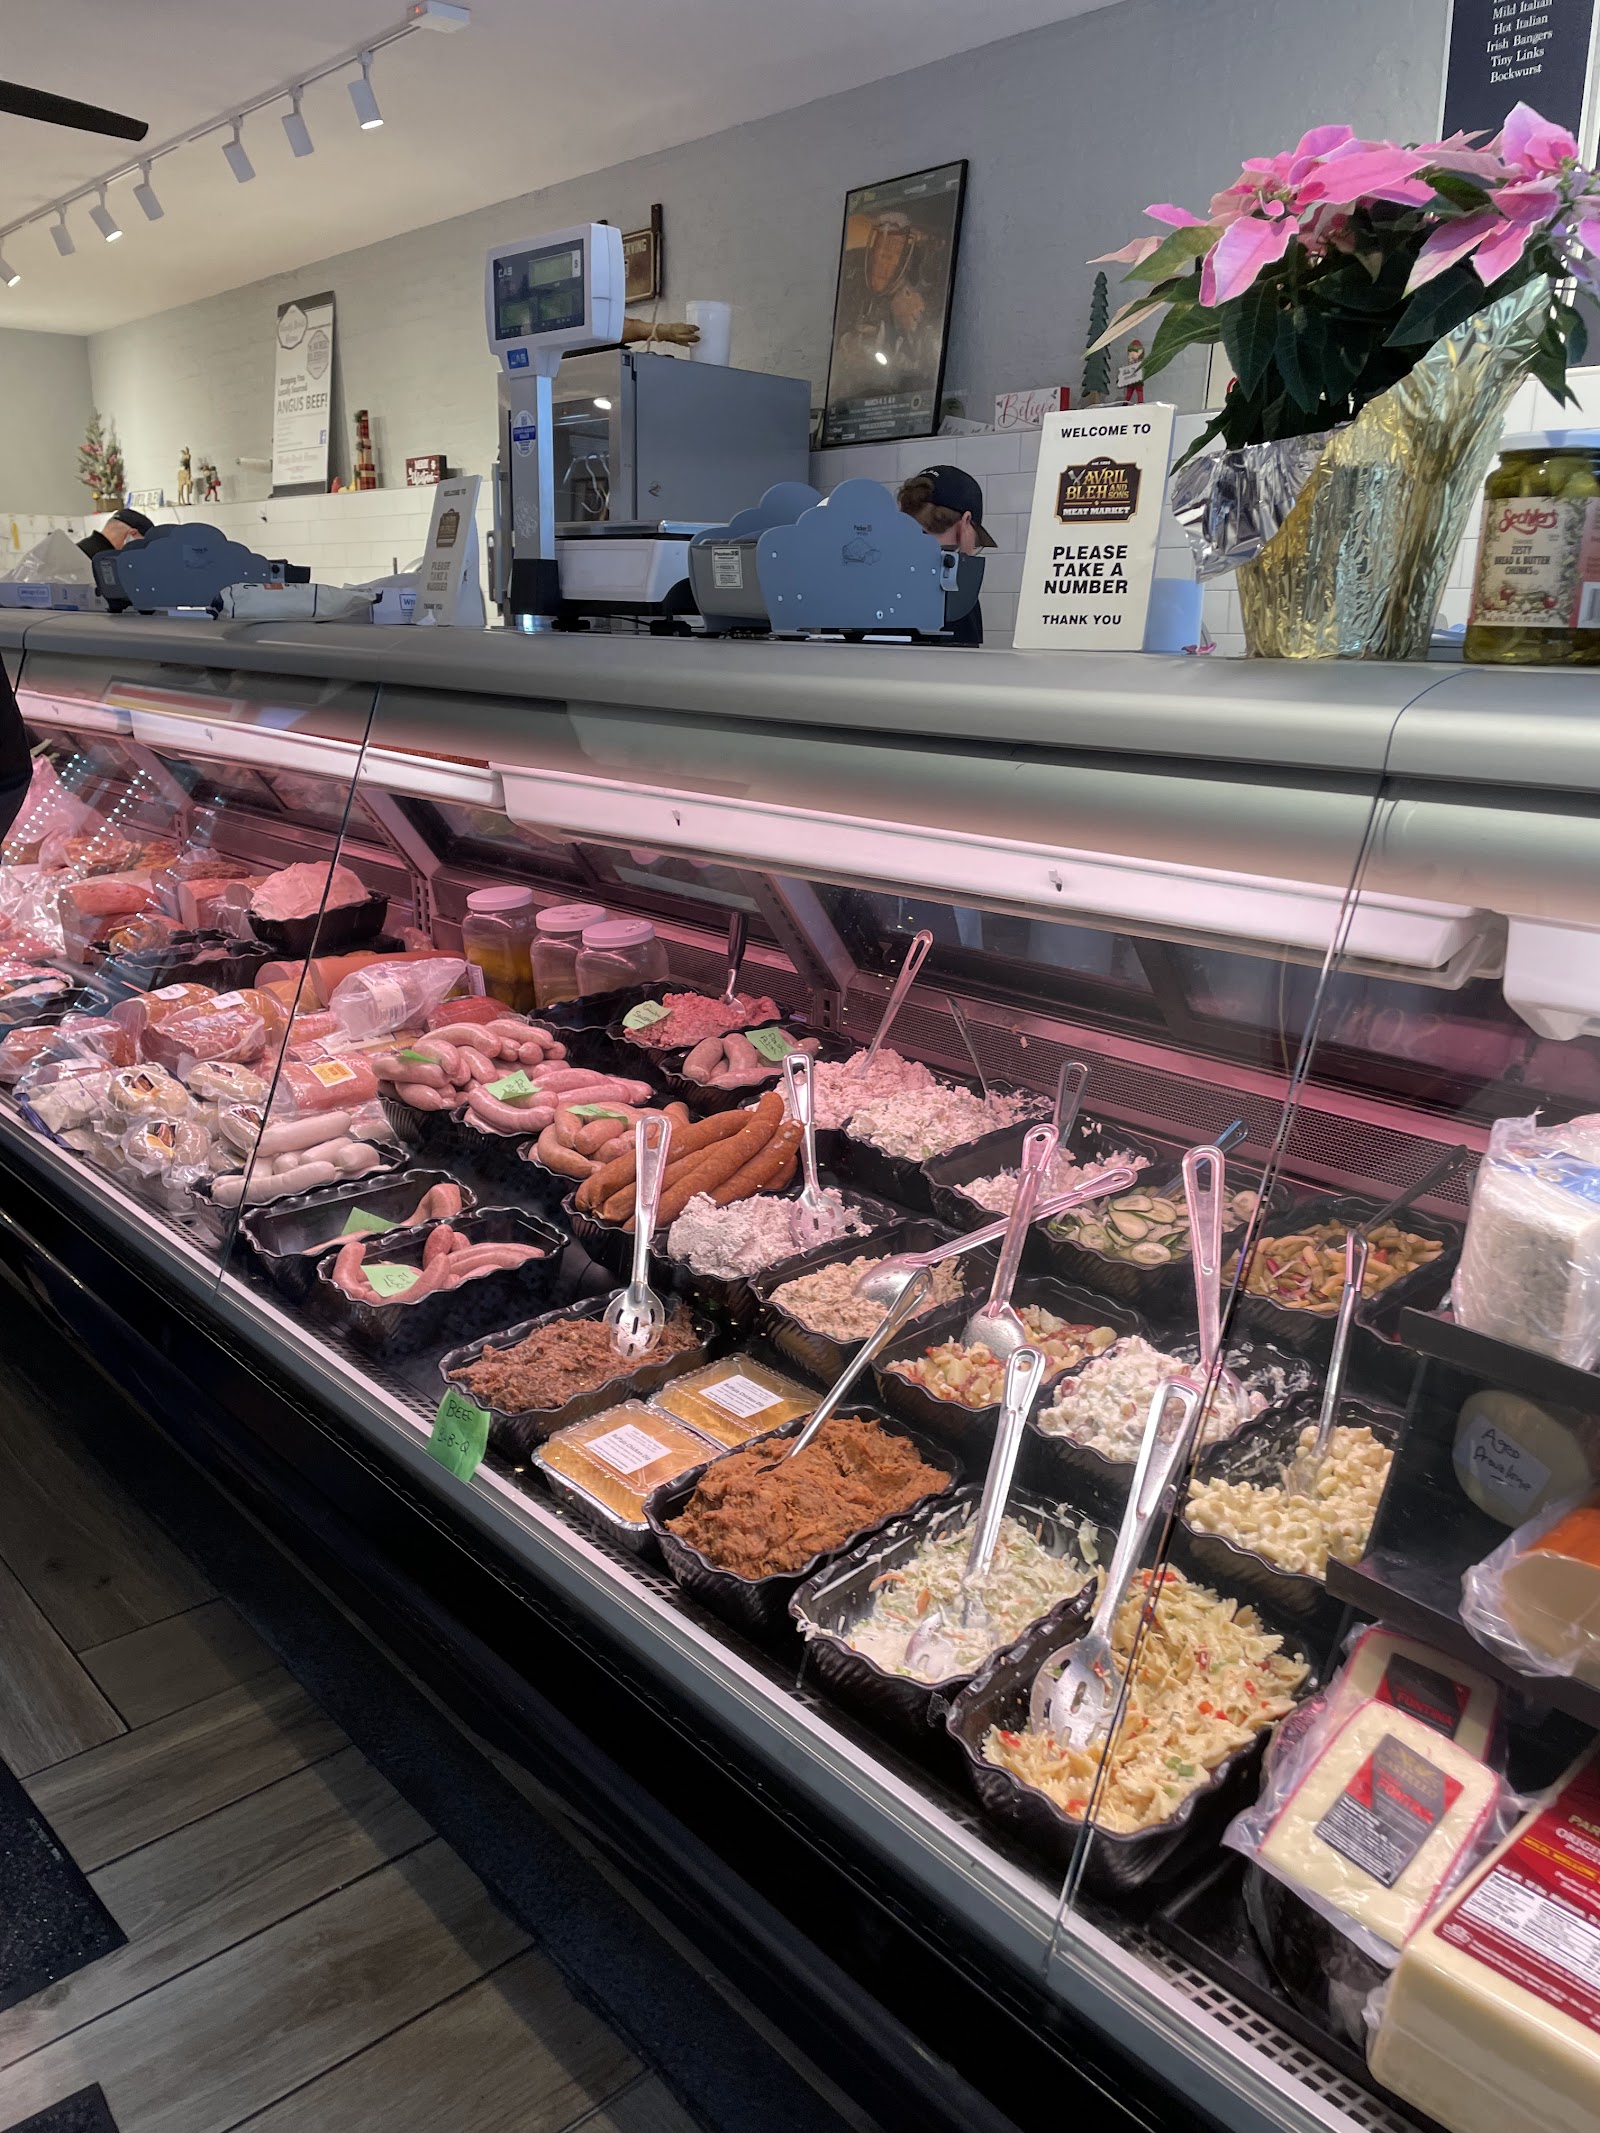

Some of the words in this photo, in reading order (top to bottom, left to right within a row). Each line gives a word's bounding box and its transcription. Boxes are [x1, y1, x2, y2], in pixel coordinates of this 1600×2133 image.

[1493, 3, 1516, 20] Mild
[1519, 0, 1553, 13] Italian
[1493, 22, 1512, 36] Hot
[1515, 14, 1549, 30] Italian
[1486, 37, 1509, 53] Irish
[1513, 30, 1553, 47] Bangers
[1491, 54, 1513, 68] Tiny
[1515, 46, 1545, 62] Links
[1489, 63, 1543, 84] Bockwurst
[276, 396, 304, 415] ANGUS
[305, 392, 328, 410] BEEF!
[997, 392, 1056, 428] Believe
[1061, 424, 1128, 438] WELCOME
[1133, 423, 1151, 434] TO
[1082, 467, 1128, 485] AVRIL
[1065, 484, 1108, 501] BLEH
[1108, 483, 1127, 492] AND
[1108, 491, 1129, 499] SONS
[1062, 507, 1089, 516] MEAT
[1090, 506, 1131, 515] MARKET
[1052, 544, 1128, 560] PLEASE
[1511, 545, 1533, 555] ZESTY
[431, 561, 451, 571] PLEASE
[1494, 556, 1513, 565] BREAD
[1523, 555, 1551, 565] BUTTER
[1052, 562, 1104, 577] TAKE
[1110, 562, 1124, 577] A
[1505, 565, 1533, 575] CHUNKS
[1043, 579, 1128, 595] NUMBER
[1042, 614, 1088, 625] THANK
[1093, 614, 1122, 625] YOU
[723, 1383, 739, 1394] Buffalo
[739, 1391, 757, 1403] Chicken
[446, 1399, 475, 1422] BEEF
[611, 1433, 627, 1446] Buffalo
[626, 1443, 643, 1456] Chicken
[1375, 1778, 1435, 1825] FONTINA
